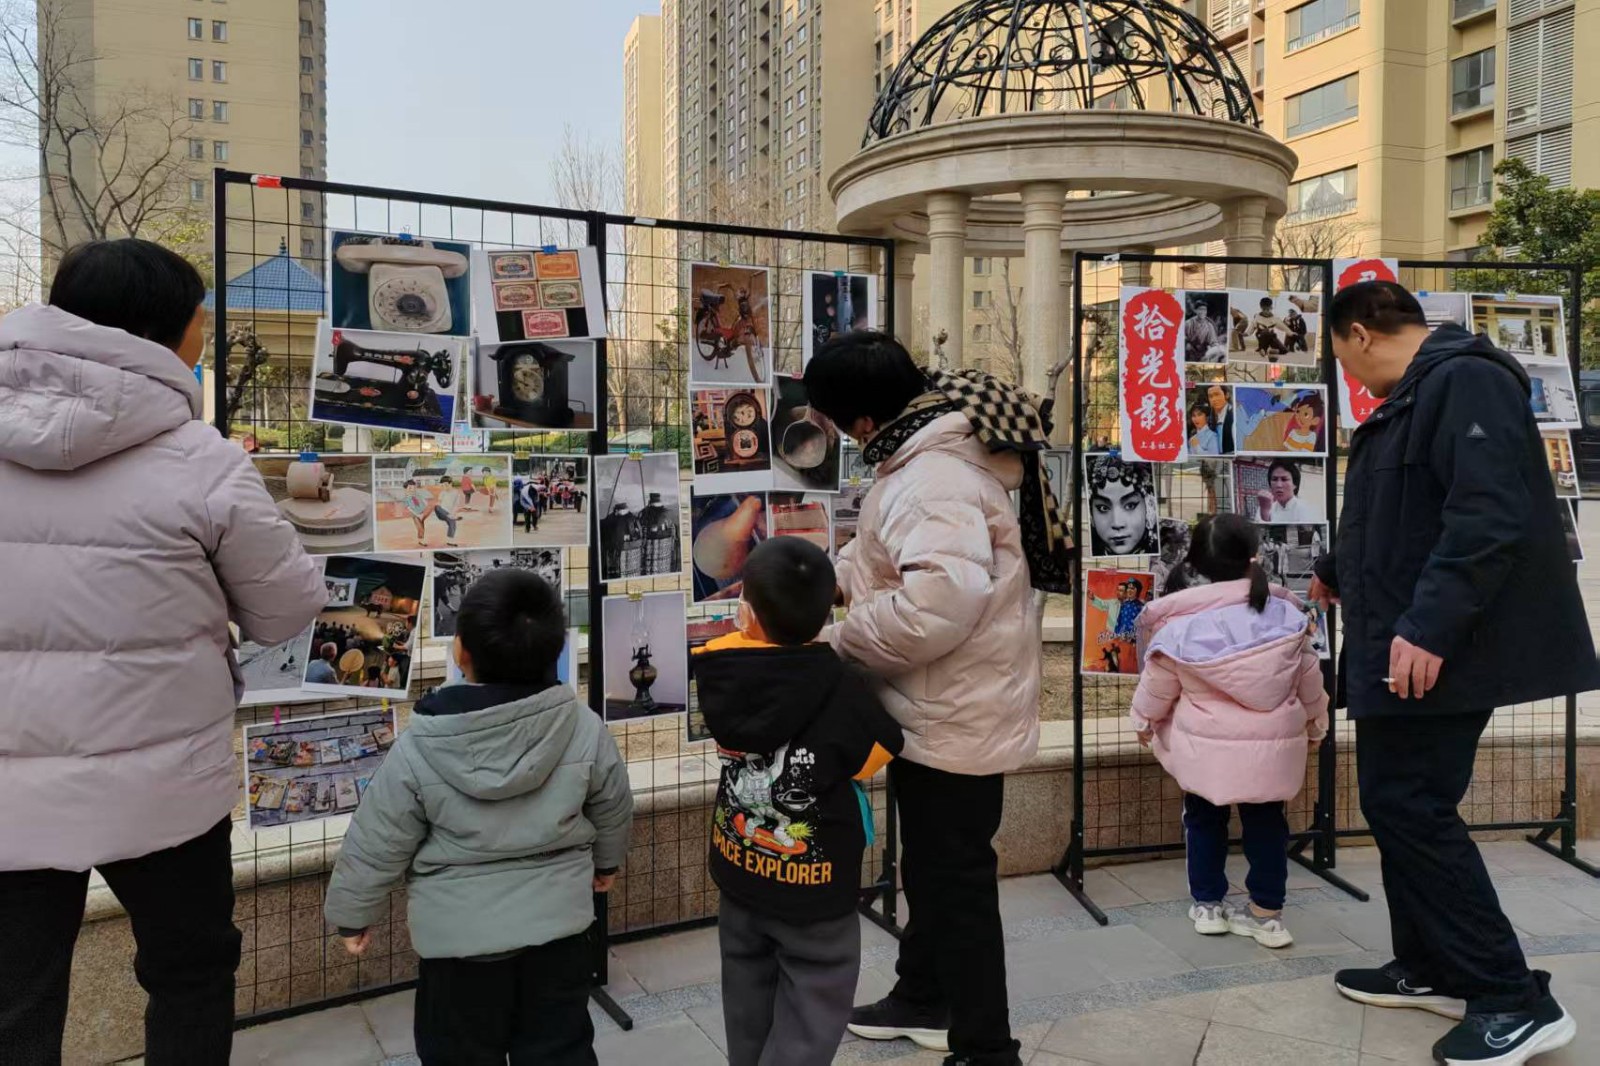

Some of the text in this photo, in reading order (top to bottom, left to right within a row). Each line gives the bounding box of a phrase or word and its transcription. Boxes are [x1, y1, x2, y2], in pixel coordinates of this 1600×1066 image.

[1133, 302, 1175, 435] 拾光影
[713, 823, 832, 884] SPACE EXPLORER
